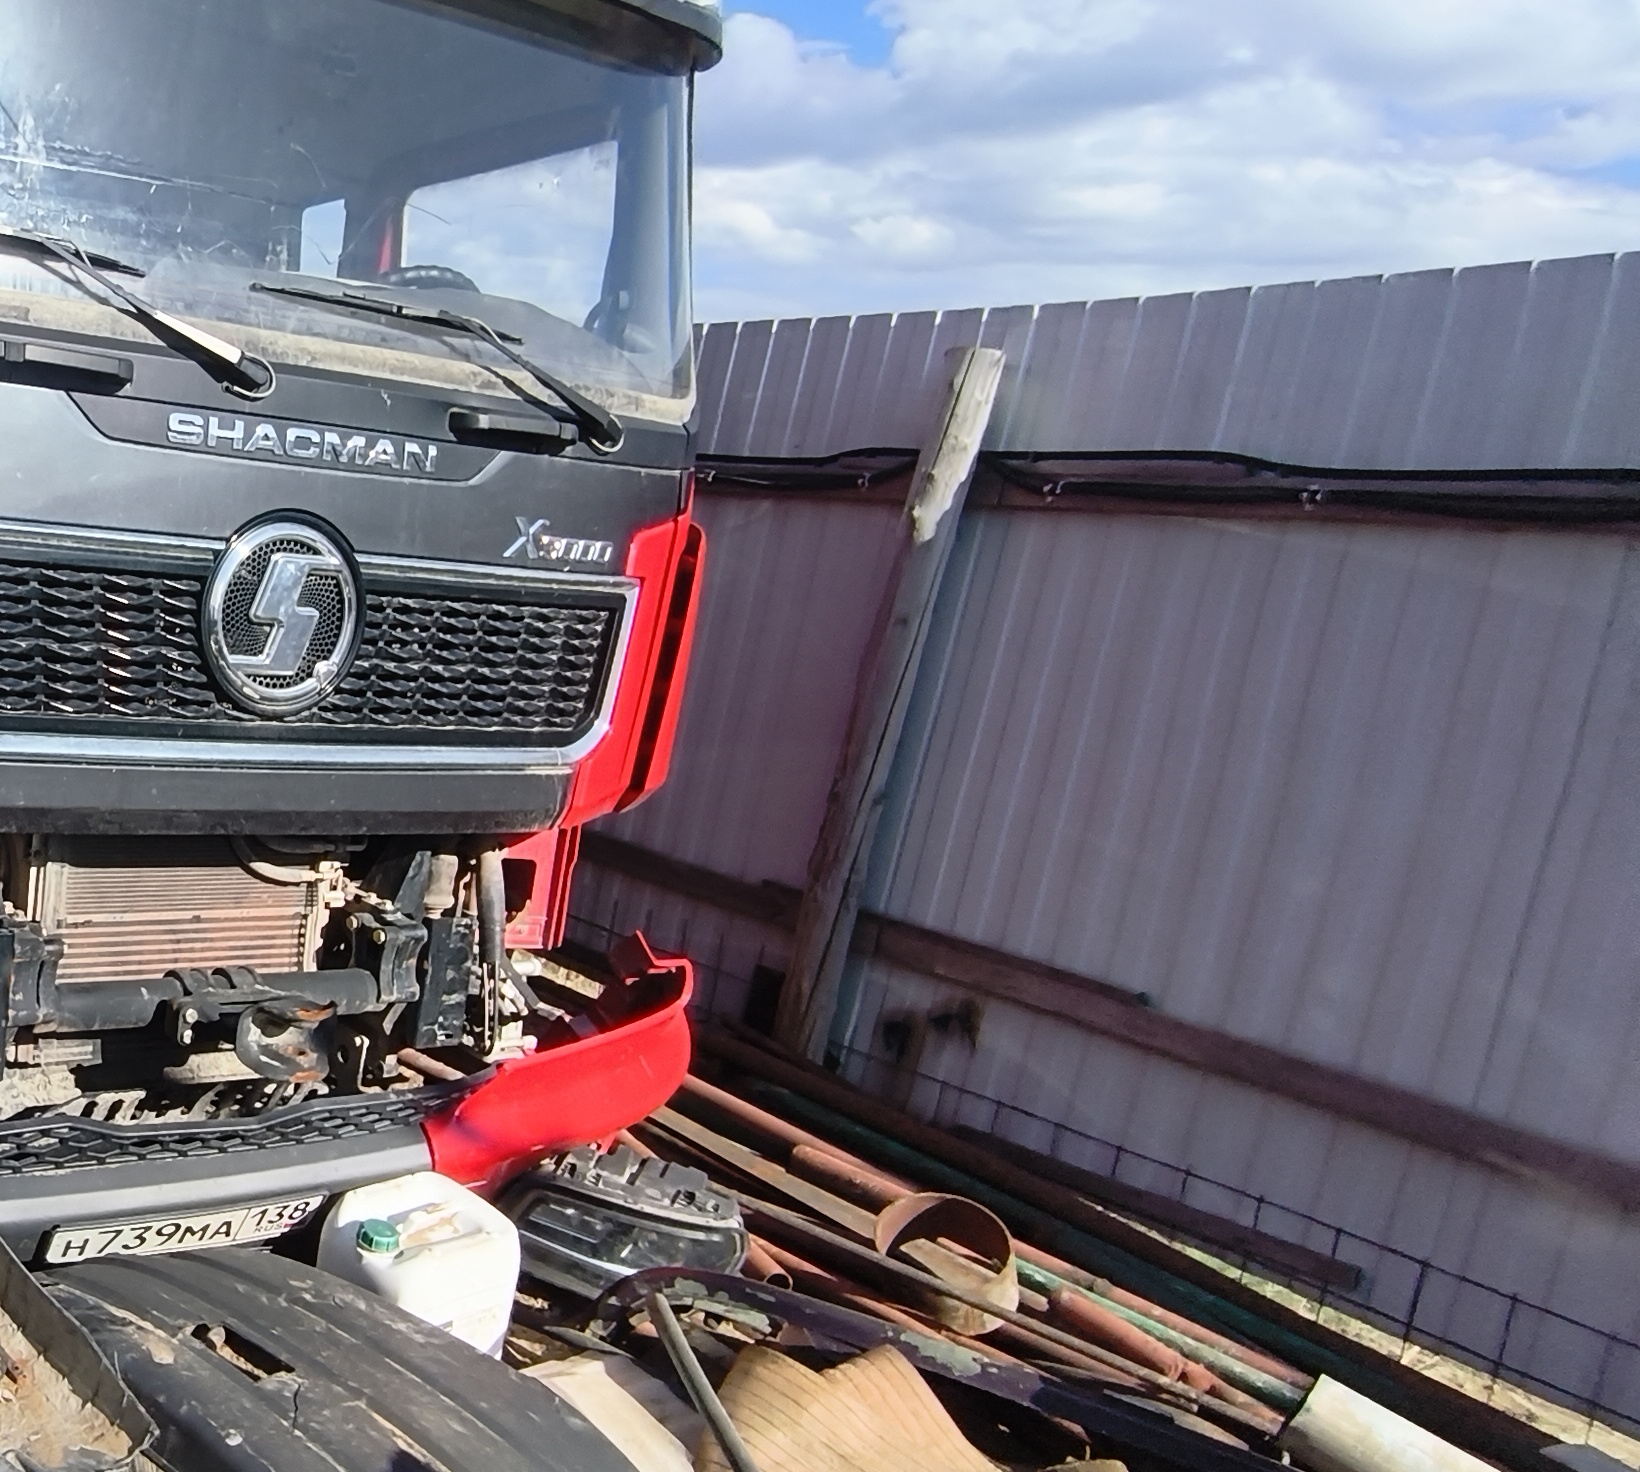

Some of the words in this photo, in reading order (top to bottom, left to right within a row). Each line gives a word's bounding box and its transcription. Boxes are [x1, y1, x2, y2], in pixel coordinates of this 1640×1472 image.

[167, 412, 438, 472] SHACMAN
[251, 1201, 311, 1227] 138
[253, 1222, 283, 1234] RUS
